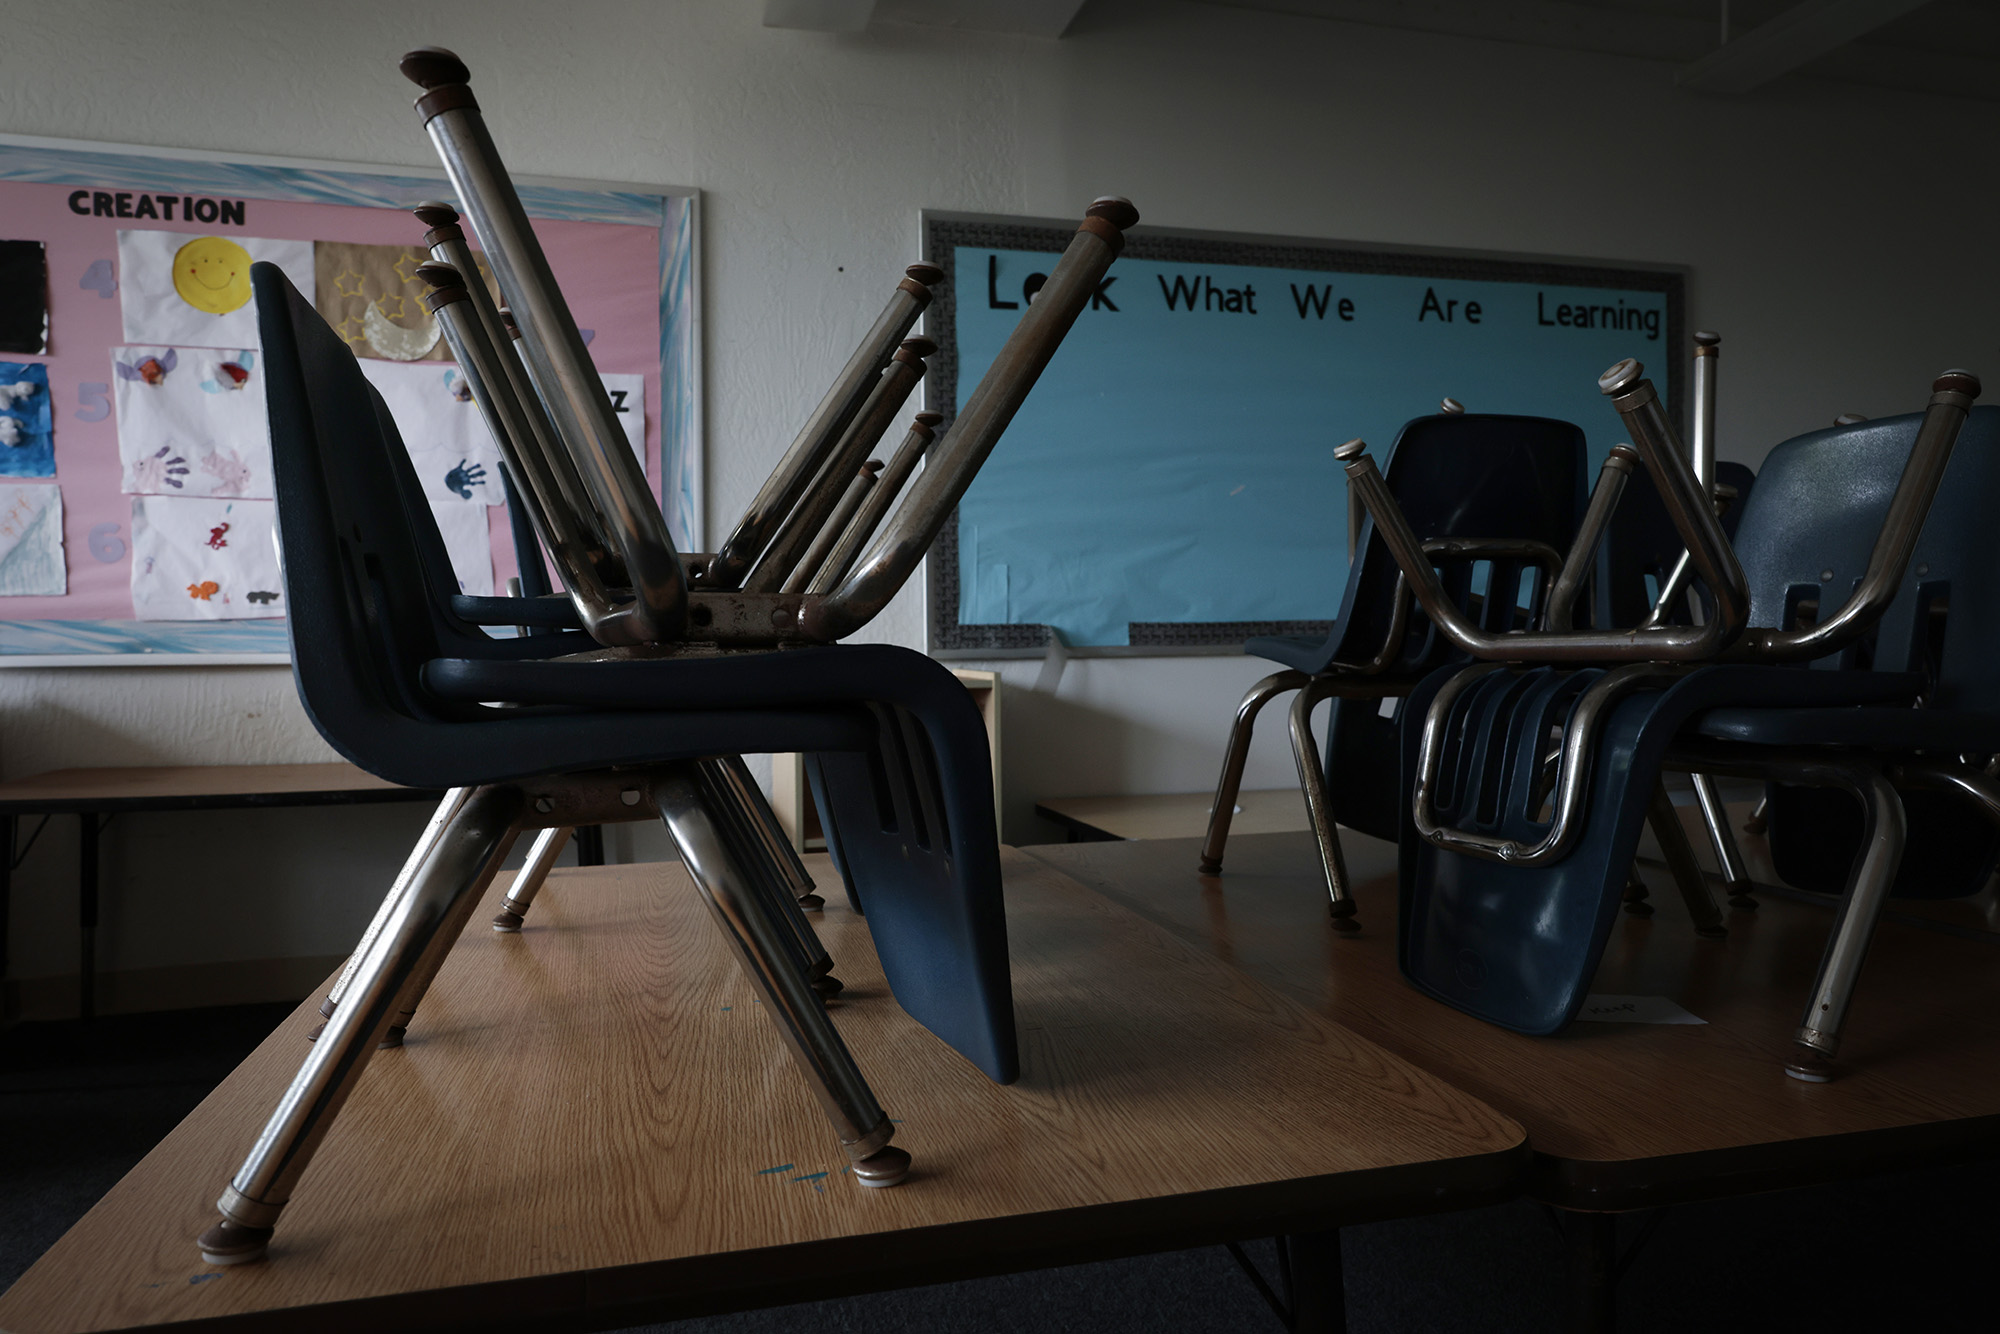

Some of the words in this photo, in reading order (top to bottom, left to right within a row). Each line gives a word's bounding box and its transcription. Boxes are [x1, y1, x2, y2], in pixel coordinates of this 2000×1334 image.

[68, 190, 245, 225] CREATION
[79, 259, 119, 299] 4
[1158, 275, 1257, 314] What
[1290, 284, 1355, 321] We
[1419, 287, 1482, 323] Are
[1538, 292, 1660, 340] Learning
[73, 382, 111, 422] 5
[88, 522, 126, 564] 6
